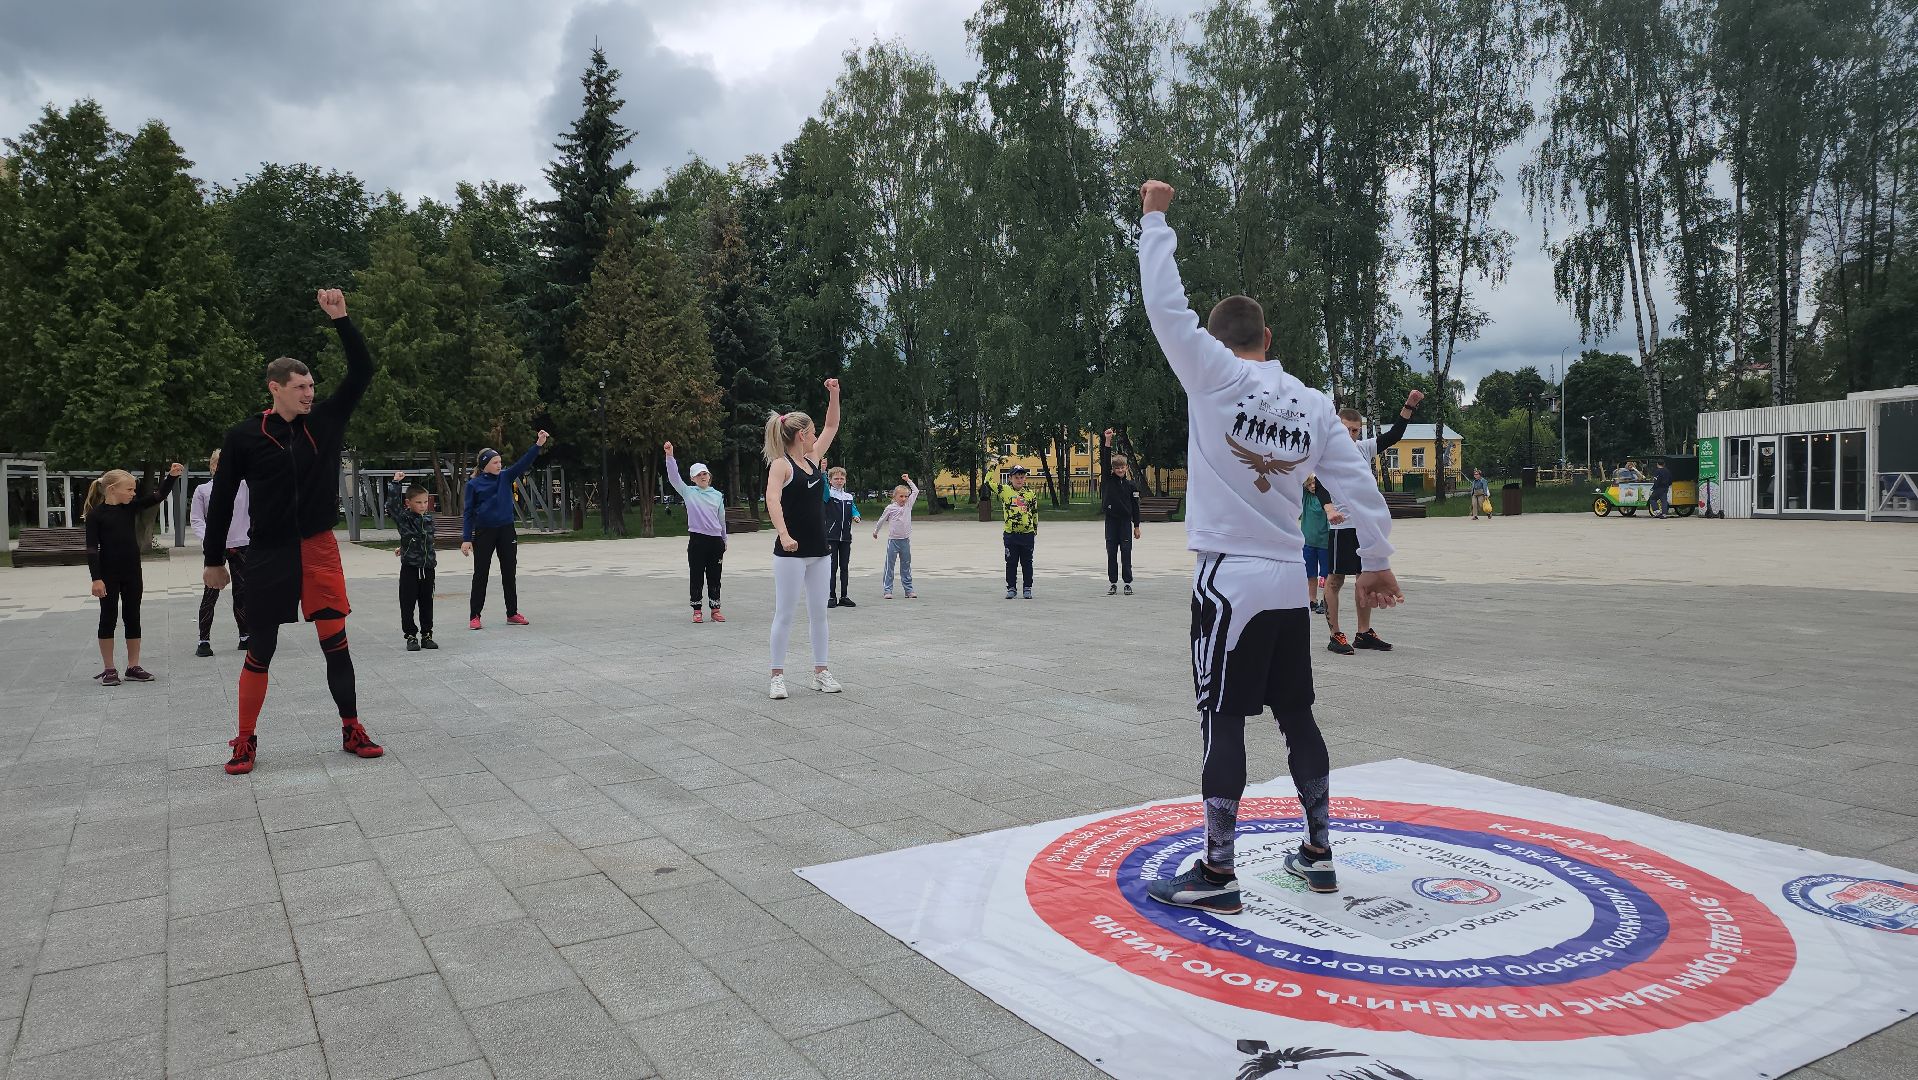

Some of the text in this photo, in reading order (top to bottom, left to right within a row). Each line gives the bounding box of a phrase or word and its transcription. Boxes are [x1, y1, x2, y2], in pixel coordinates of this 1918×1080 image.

[1488, 823, 1634, 861] КАЖДЫЙ
[1493, 843, 1608, 885] ФЕДЕРАЦИЯ
[1617, 860, 1690, 890] ДЕНЬ
[1390, 896, 1567, 951] ММА ДЗЮДО САМБО
[1599, 887, 1642, 949] СМЕШАННОГО
[1690, 896, 1734, 922] ЭТО
[1090, 914, 1184, 962] ЖИЗНЬ
[1708, 923, 1750, 954] ЕЩЁ
[1181, 959, 1302, 998] СВОЮ
[1255, 944, 1500, 979] ЕДИНОБОРСТВА
[1665, 953, 1736, 989] ОДИН
[1316, 989, 1563, 1019] ИЗМЕНИТЬ
[1563, 983, 1682, 1015] ШАНС
